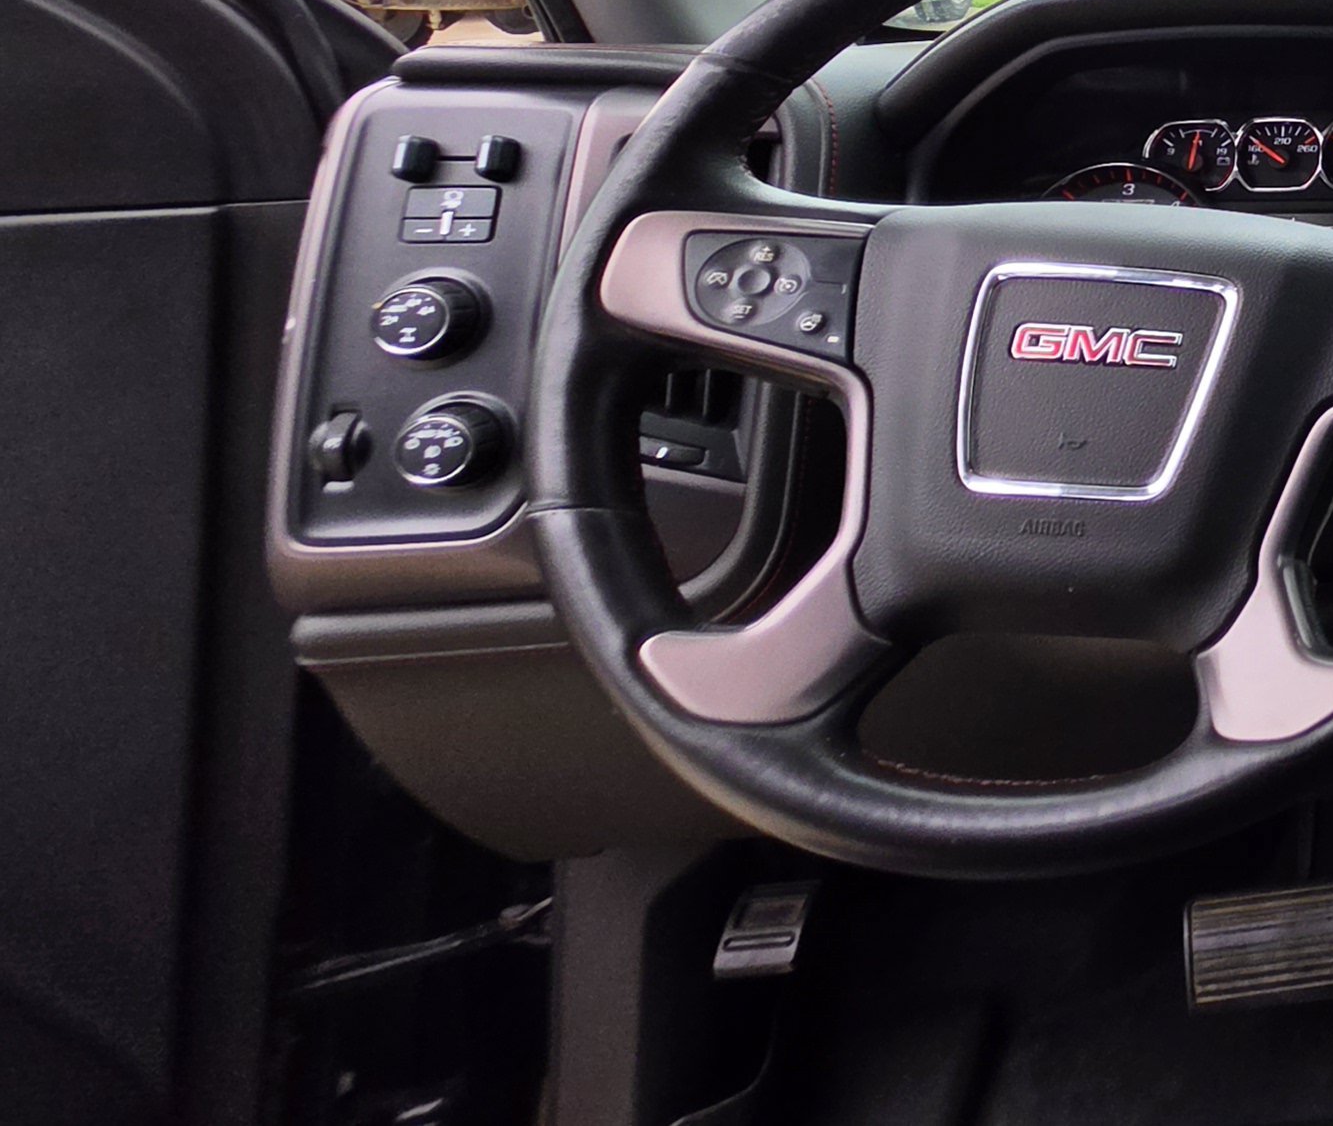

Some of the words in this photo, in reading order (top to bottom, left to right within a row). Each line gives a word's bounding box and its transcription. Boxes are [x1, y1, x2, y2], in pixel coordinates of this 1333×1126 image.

[1167, 147, 1176, 156] 9
[1216, 147, 1228, 156] 19
[1274, 137, 1292, 146] 210
[1297, 144, 1318, 153] 260
[1121, 183, 1135, 196] 3
[753, 252, 775, 262] RES
[733, 305, 753, 315] SET
[1010, 320, 1184, 370] GMC
[1019, 519, 1087, 539] AIRBAG
